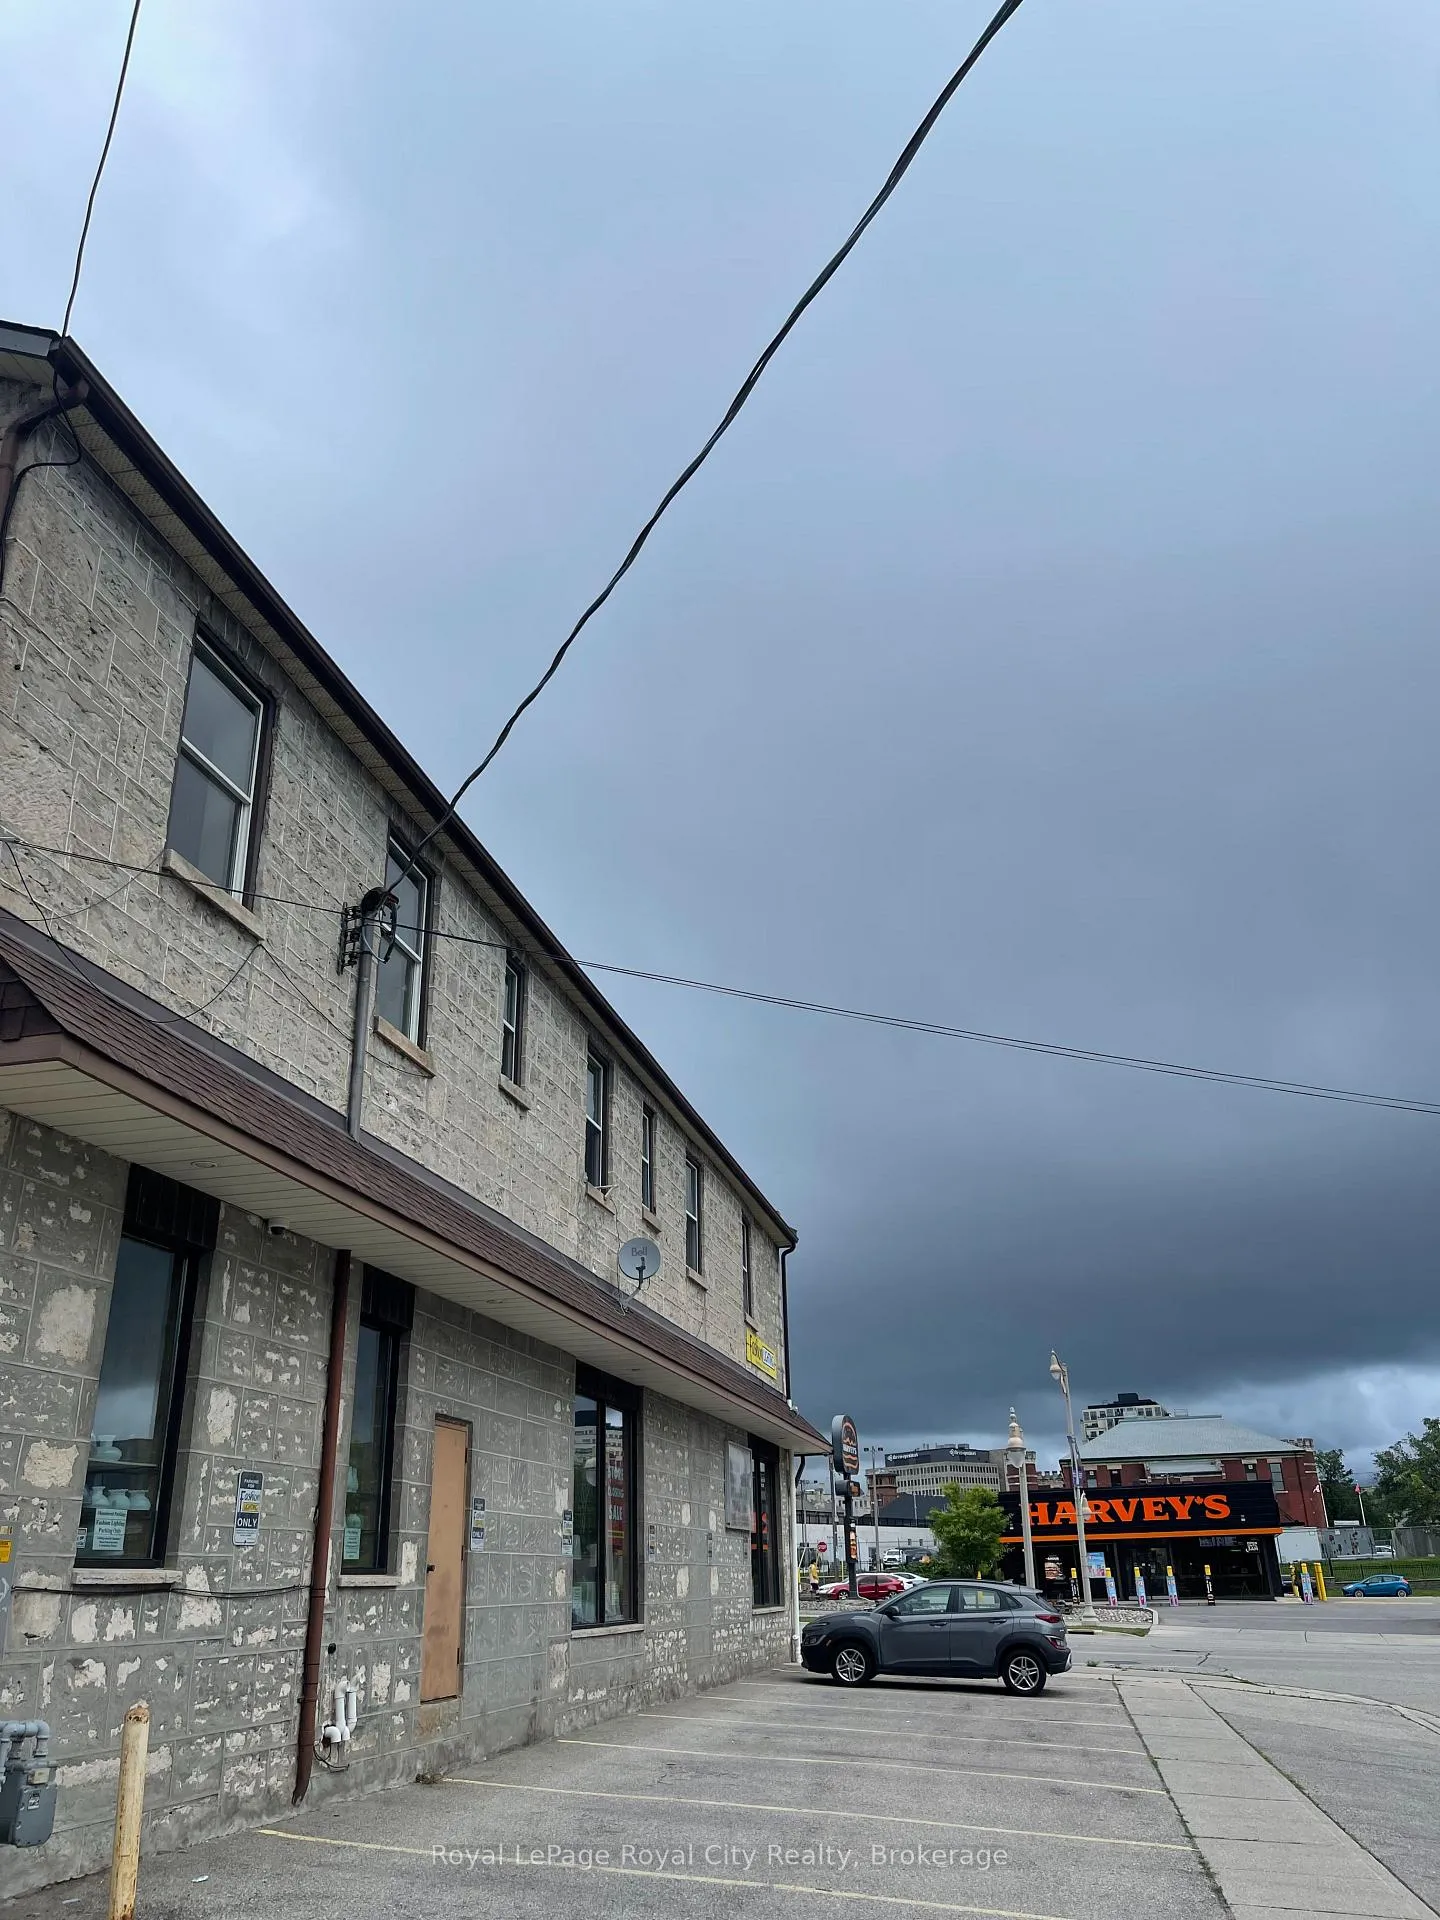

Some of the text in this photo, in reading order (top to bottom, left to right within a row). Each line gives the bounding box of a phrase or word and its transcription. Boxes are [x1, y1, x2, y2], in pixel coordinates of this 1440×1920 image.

[631, 1246, 648, 1257] Bell
[608, 1505, 623, 1520] SALE
[1019, 1494, 1231, 1526] HARVEY'S
[237, 1517, 258, 1527] ONLY
